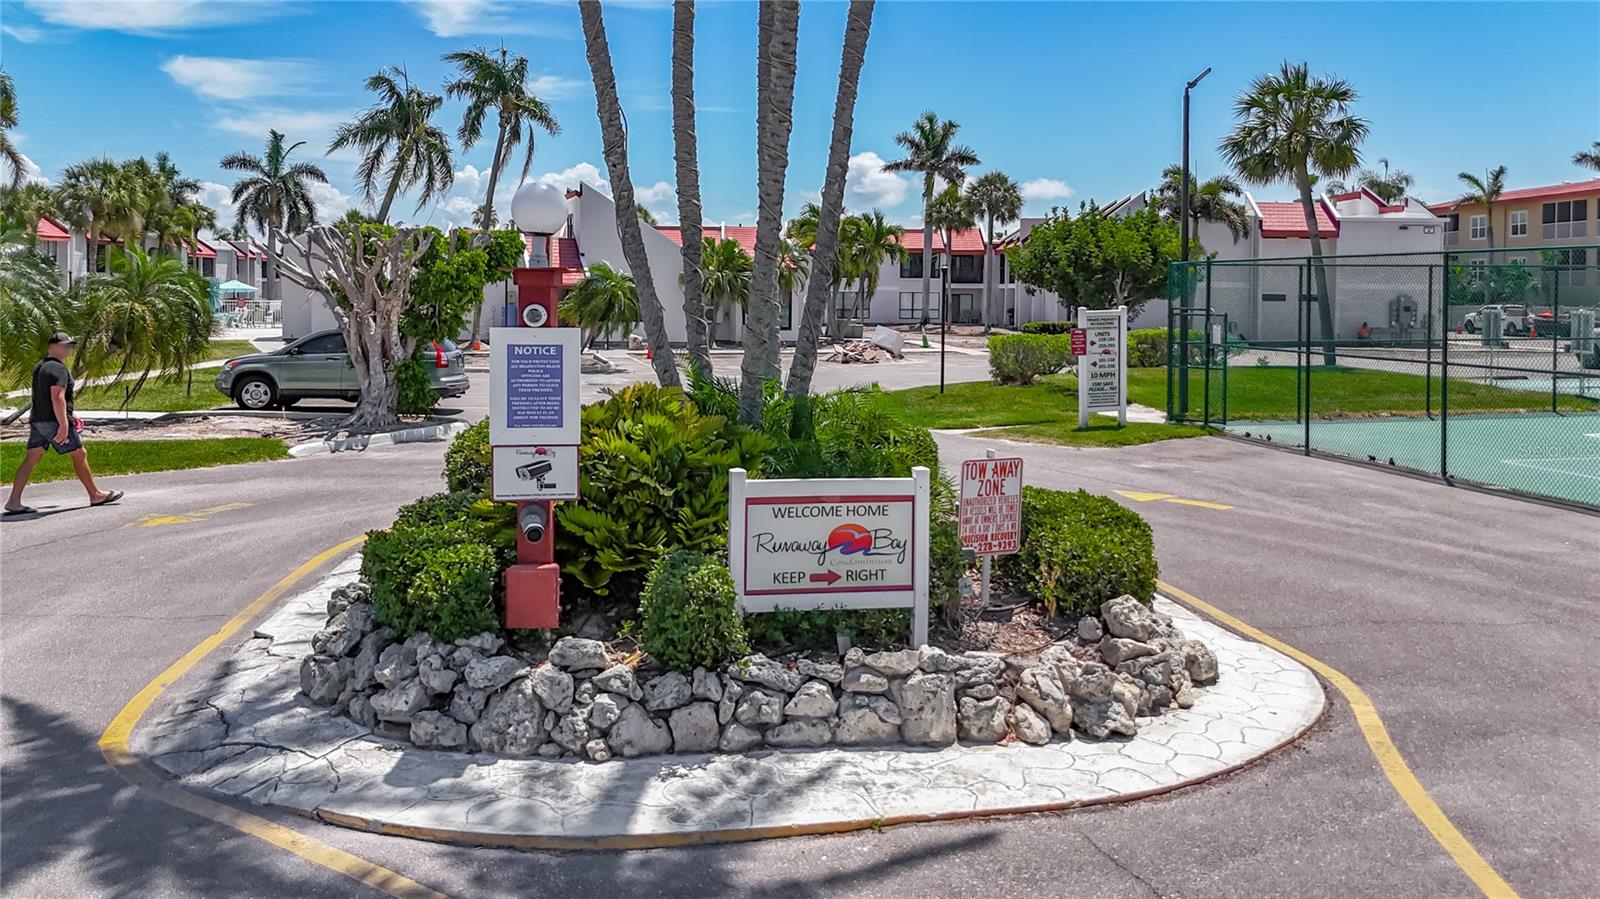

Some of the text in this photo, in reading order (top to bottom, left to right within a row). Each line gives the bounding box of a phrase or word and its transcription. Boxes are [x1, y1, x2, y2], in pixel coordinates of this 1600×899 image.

[514, 346, 556, 355] NOTICE
[965, 461, 1020, 480] TOW AWAY
[977, 478, 1005, 496] ZONE
[998, 495, 1018, 504] VEHICLES
[772, 504, 889, 518] WELCOME HOME
[981, 515, 998, 524] OWNERS
[991, 532, 1016, 541] RECOVERY
[752, 528, 907, 565] Runaway Bay
[773, 569, 887, 584] KEEP RIGHT
